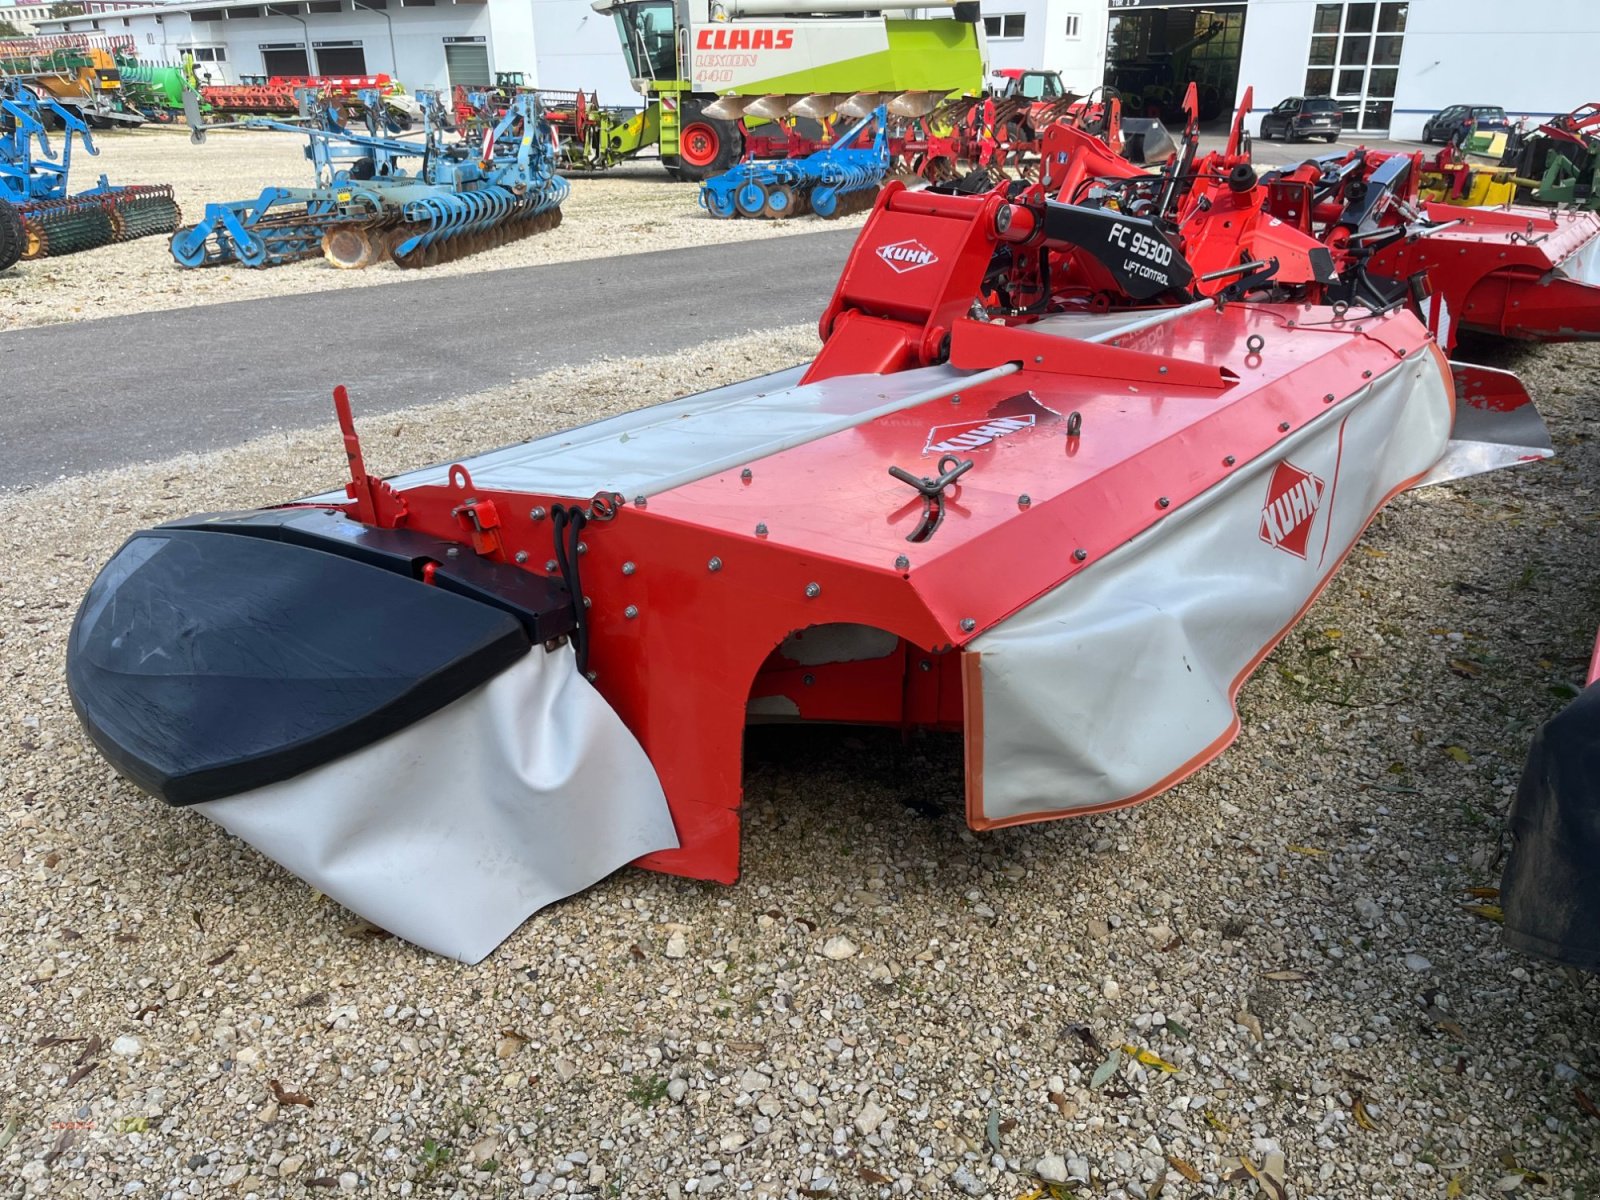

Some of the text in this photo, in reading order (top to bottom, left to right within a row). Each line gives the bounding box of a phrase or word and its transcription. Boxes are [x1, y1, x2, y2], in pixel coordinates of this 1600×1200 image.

[696, 29, 794, 50] CLAAS
[695, 54, 758, 67] LEXION
[695, 70, 733, 82] 440
[882, 245, 932, 264] KUHN
[1107, 222, 1173, 267] FC 9530D
[1123, 258, 1169, 286] LIFT CONTROL
[926, 418, 1034, 452] KUHN
[1262, 473, 1320, 548] KUHN
